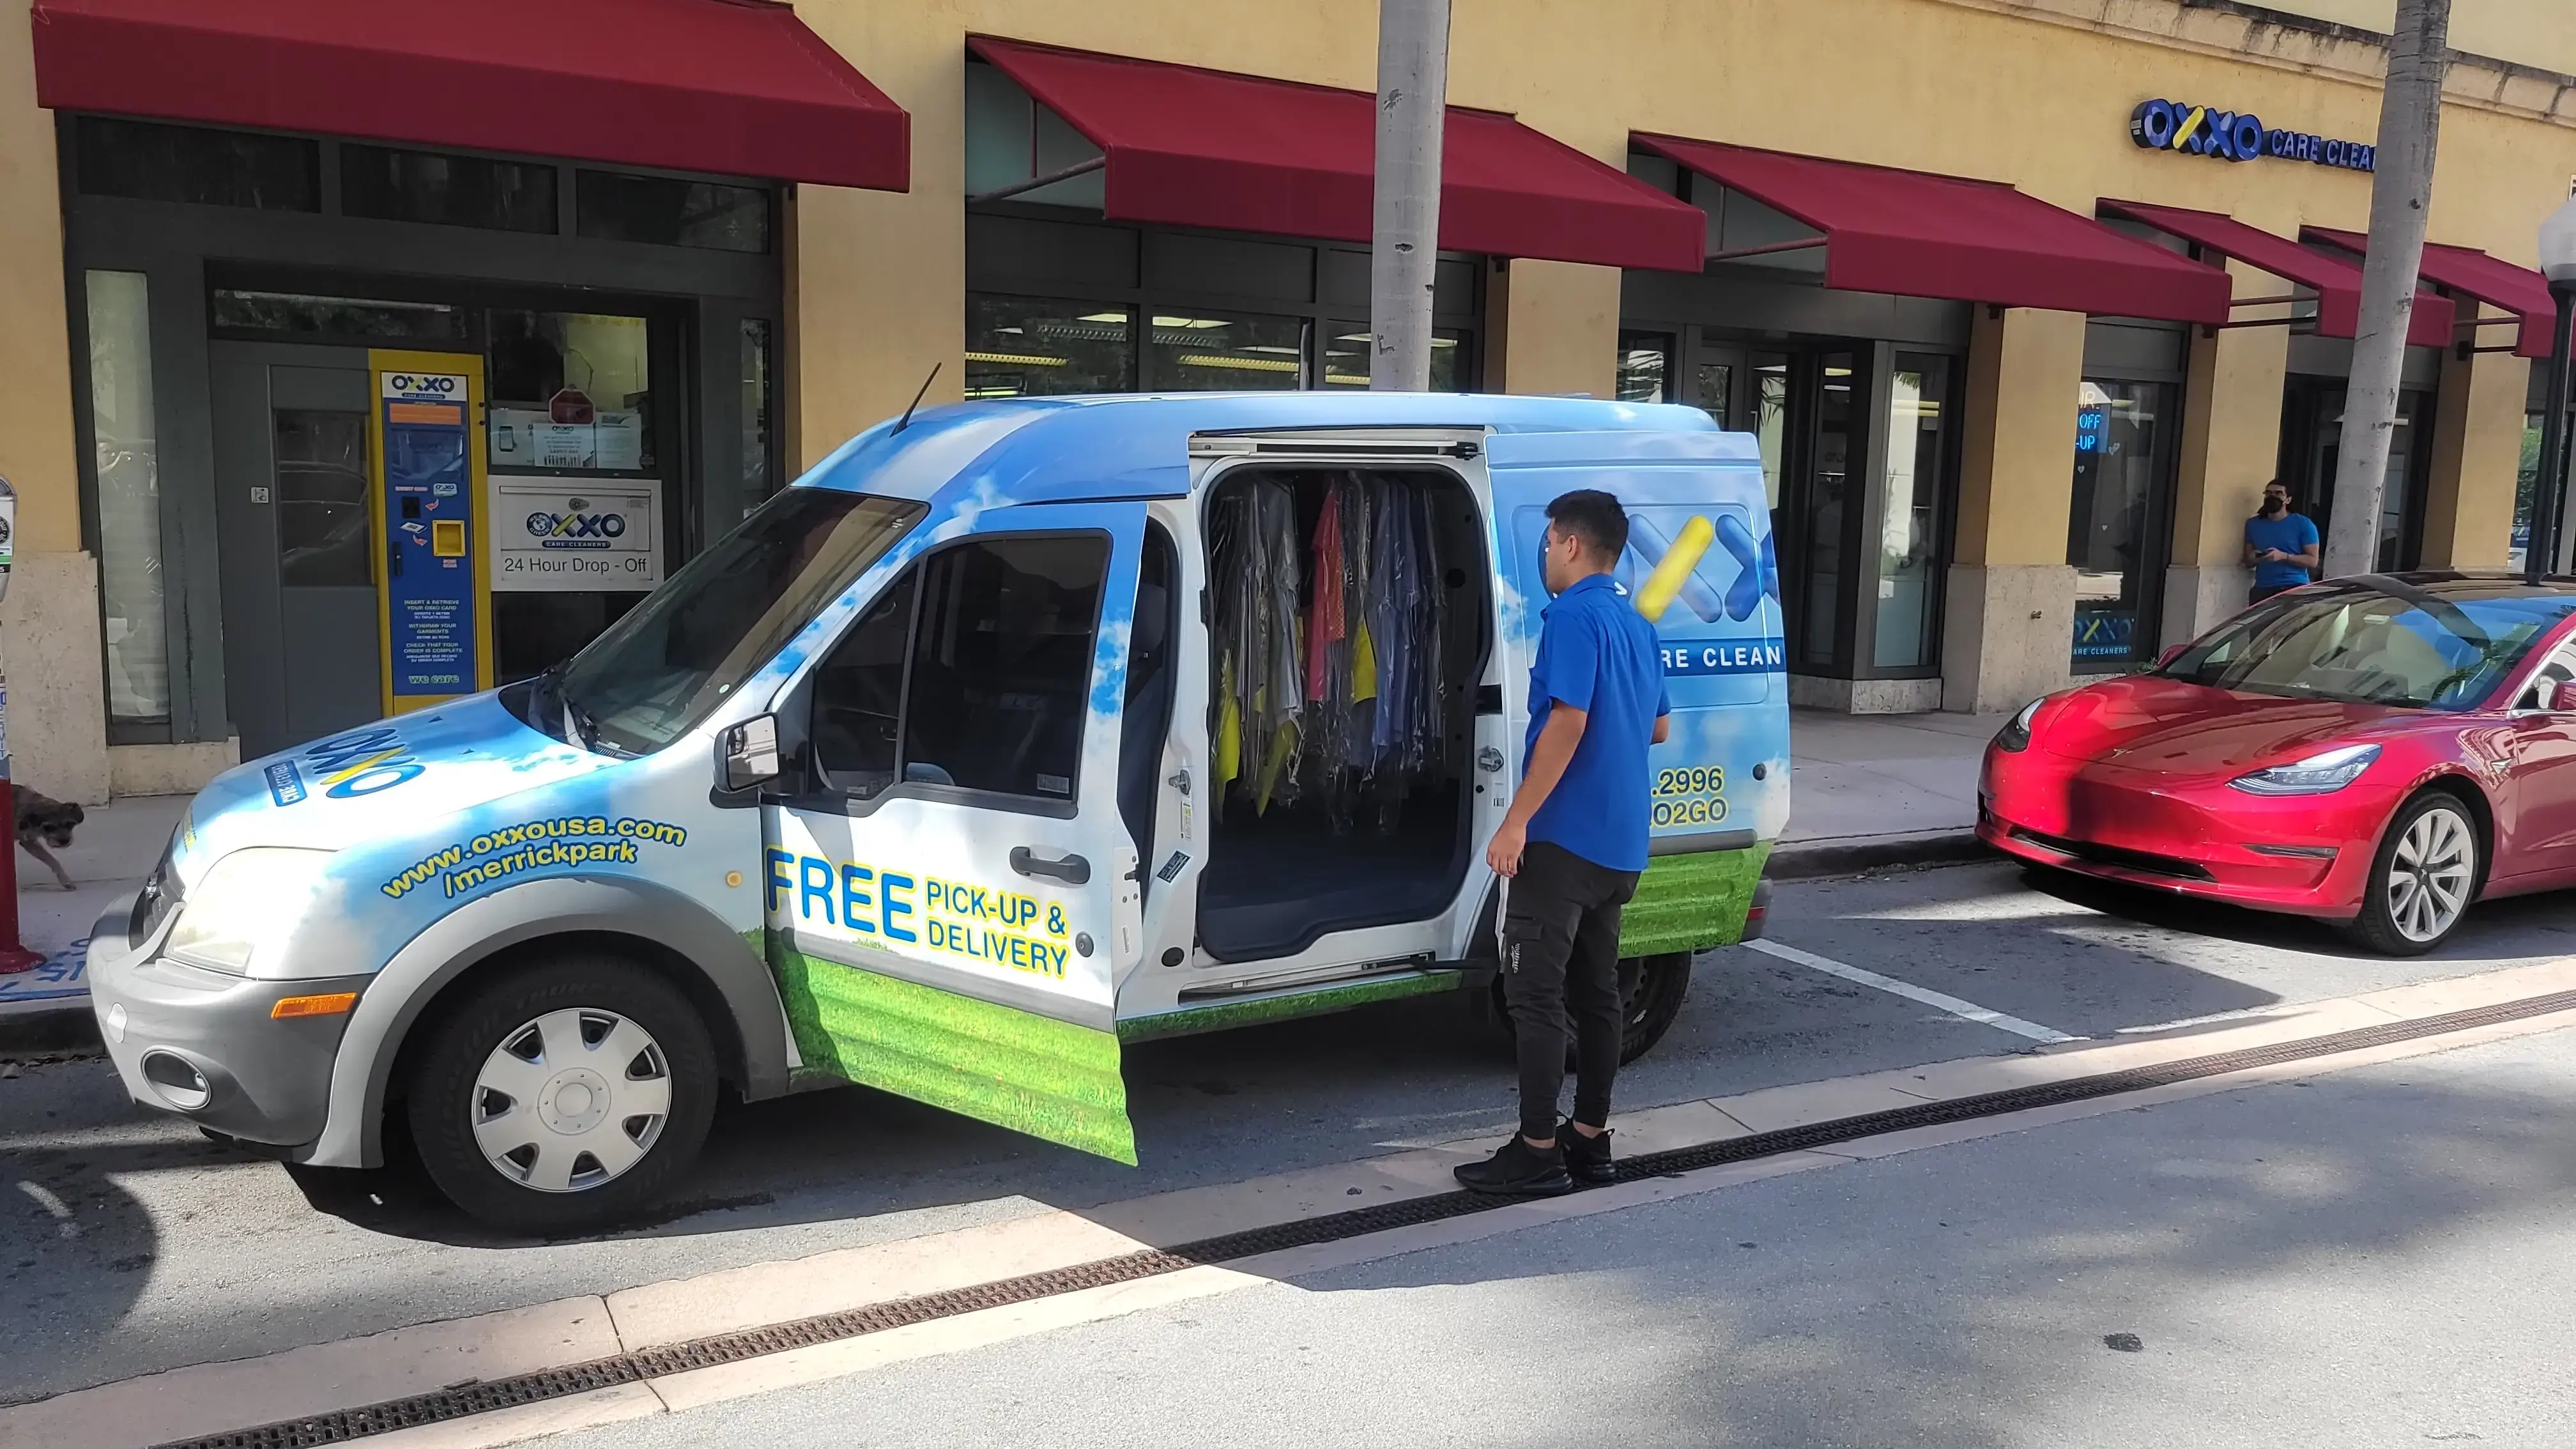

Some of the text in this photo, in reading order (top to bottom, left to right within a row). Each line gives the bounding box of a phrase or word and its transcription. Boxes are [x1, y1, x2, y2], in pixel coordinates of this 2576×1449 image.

[2130, 98, 2376, 171] OXXO CARE CLEA
[392, 375, 455, 392] OXXO
[2079, 413, 2102, 429] OFF
[527, 512, 625, 537] OXXO
[505, 558, 524, 572] 24
[530, 558, 567, 572] Hour
[573, 558, 610, 574] Drop
[625, 558, 647, 572] Off
[1703, 646, 1781, 667] CLEAN
[408, 675, 459, 684] we care
[305, 728, 426, 798] OXXO
[382, 817, 686, 898] www.oxxousa.com
[443, 839, 638, 898] /merrickpark
[766, 847, 1066, 943] FREE PICK-UP &
[928, 919, 1066, 976] DELIVERY
